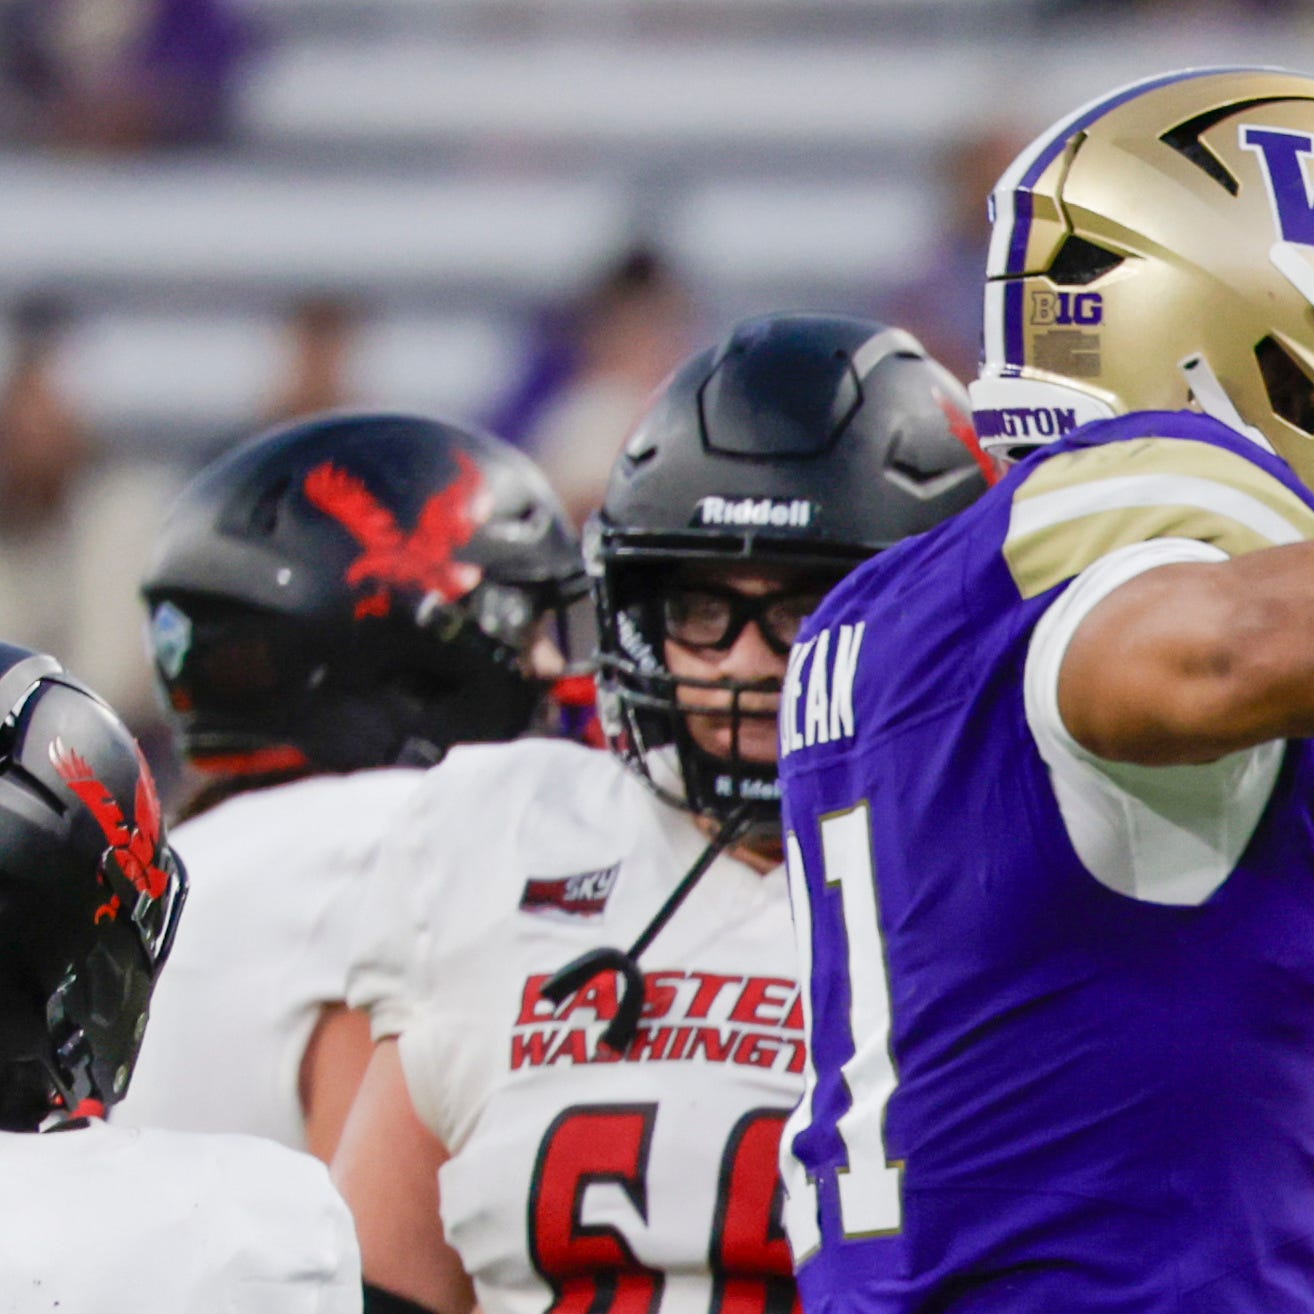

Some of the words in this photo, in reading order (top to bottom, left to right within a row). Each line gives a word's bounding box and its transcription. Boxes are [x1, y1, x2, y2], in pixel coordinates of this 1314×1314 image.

[702, 496, 810, 527] Riddell
[779, 620, 866, 758] EAN
[512, 968, 806, 1025] EASTE
